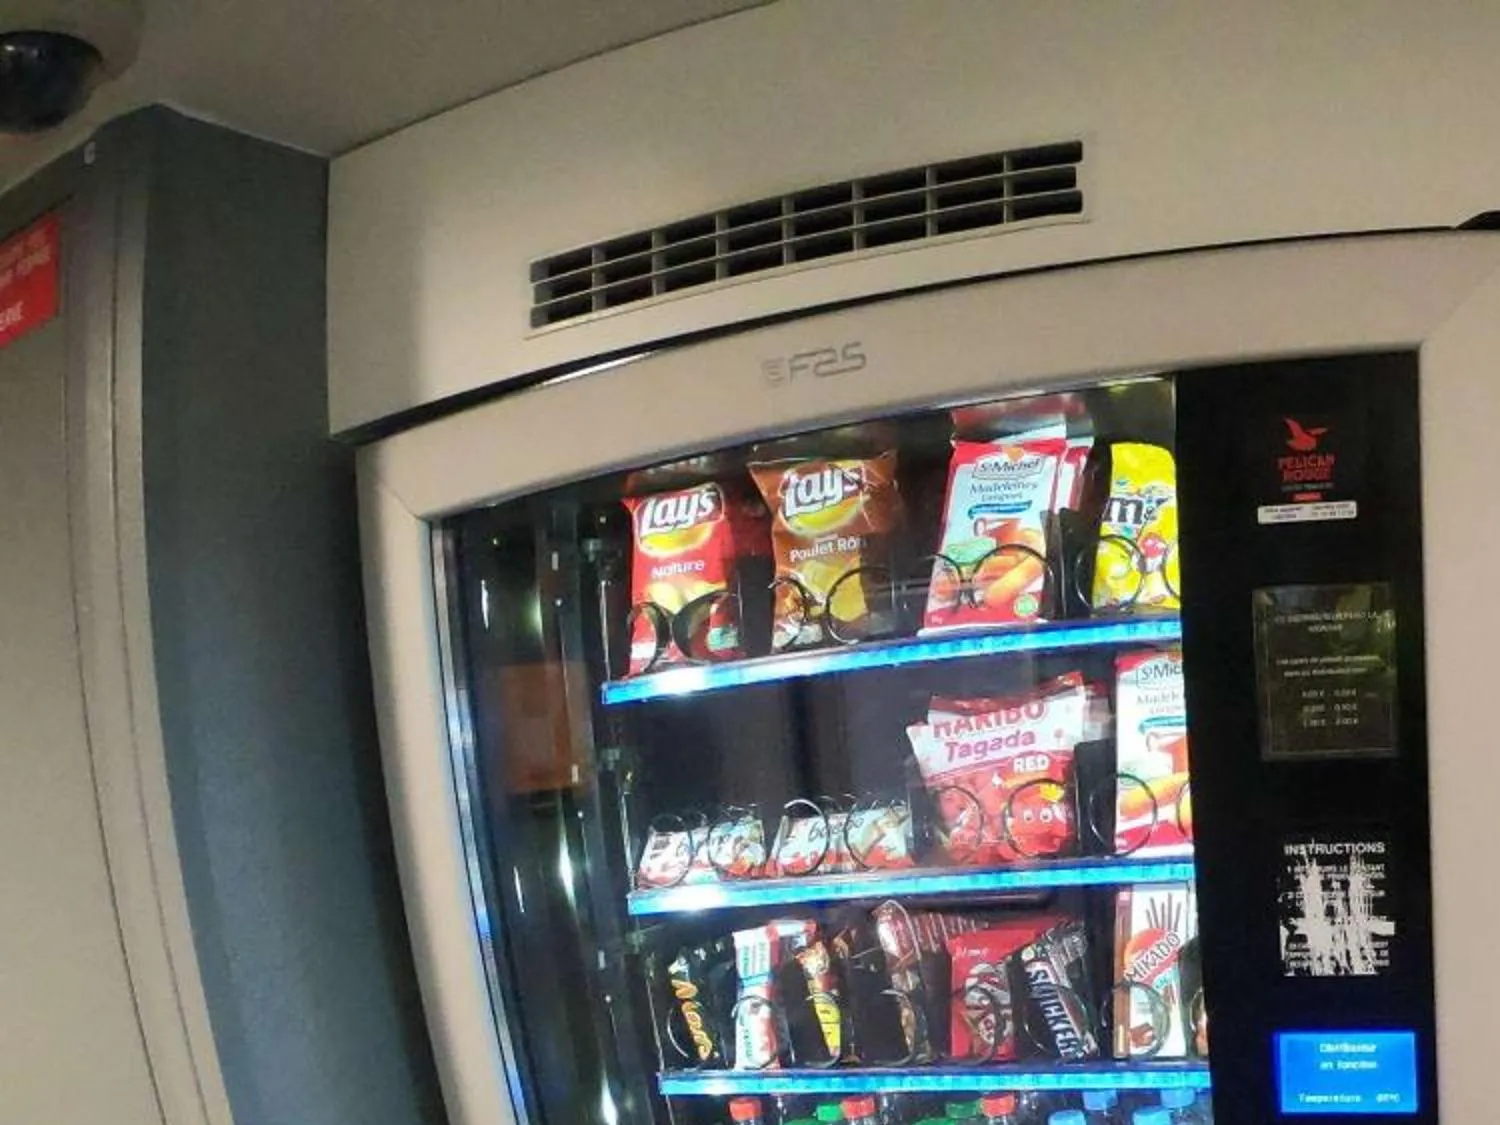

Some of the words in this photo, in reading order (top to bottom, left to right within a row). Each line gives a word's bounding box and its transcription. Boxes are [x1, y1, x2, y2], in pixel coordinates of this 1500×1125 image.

[790, 540, 833, 562] Poulet
[652, 560, 705, 578] Nature
[944, 728, 1037, 762] Tagada
[1012, 754, 1050, 772] RED
[1284, 841, 1386, 856] INSTRUCTIONS
[1124, 929, 1182, 982] MIKADO
